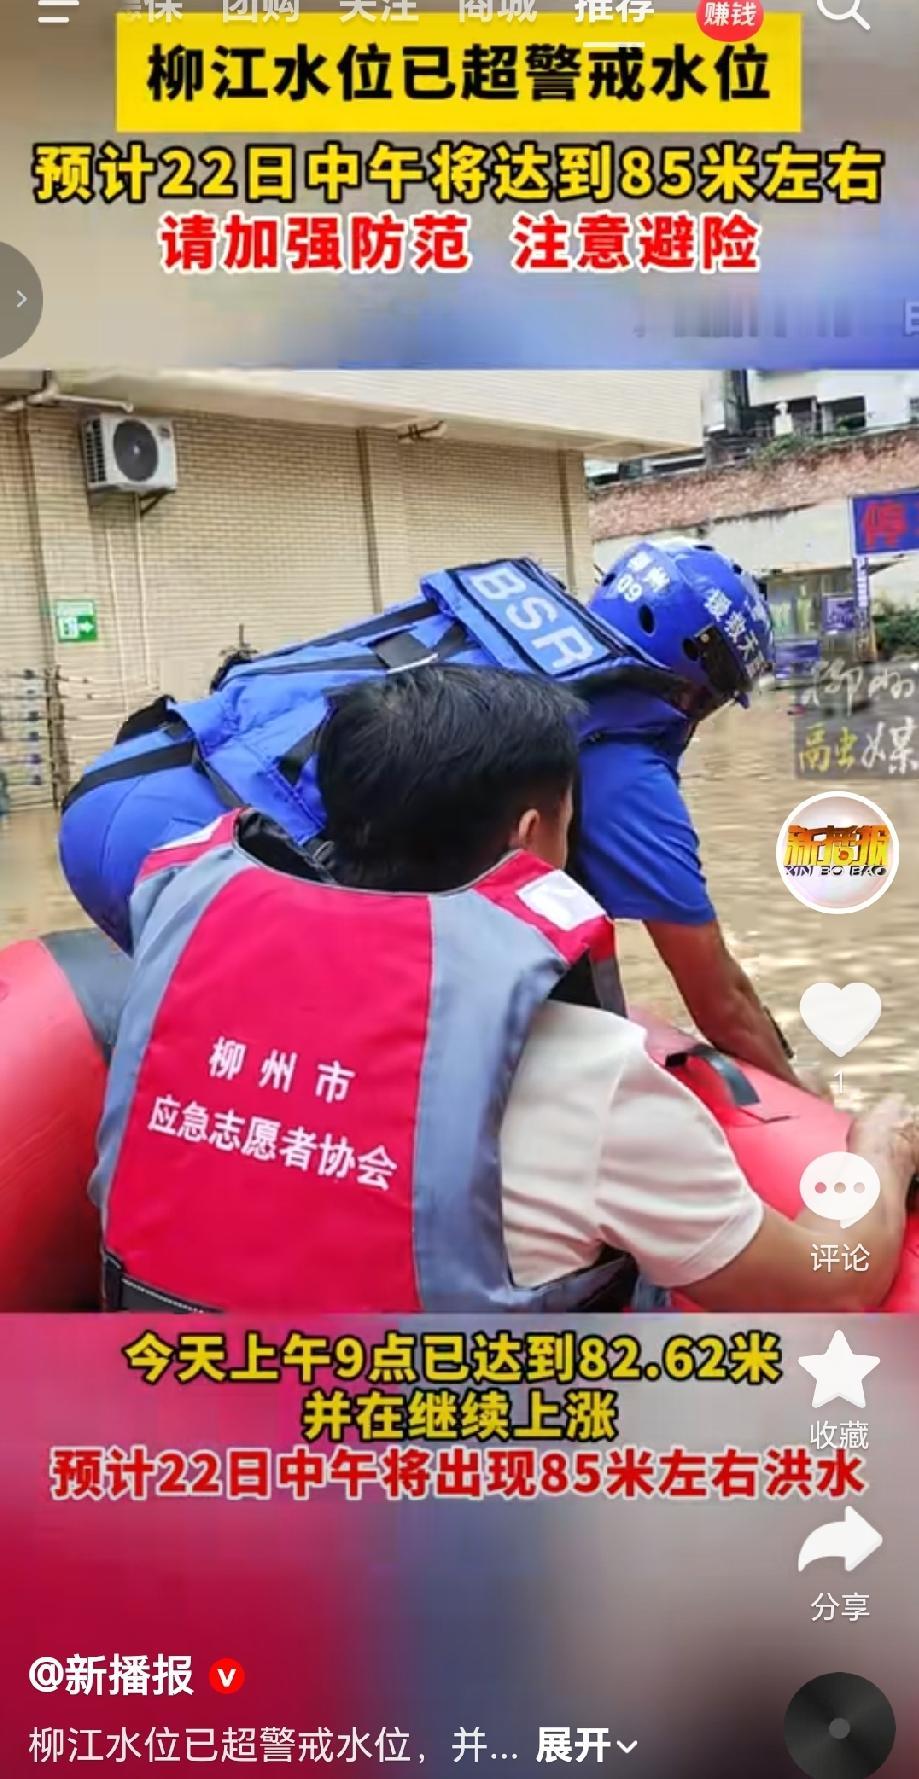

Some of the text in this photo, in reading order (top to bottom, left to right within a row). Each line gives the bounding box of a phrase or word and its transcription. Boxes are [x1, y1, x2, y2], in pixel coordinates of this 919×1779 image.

[468, 568, 594, 669] BSR
[208, 1036, 355, 1103] 柳州市
[148, 1094, 398, 1191] 应急志愿者协会
